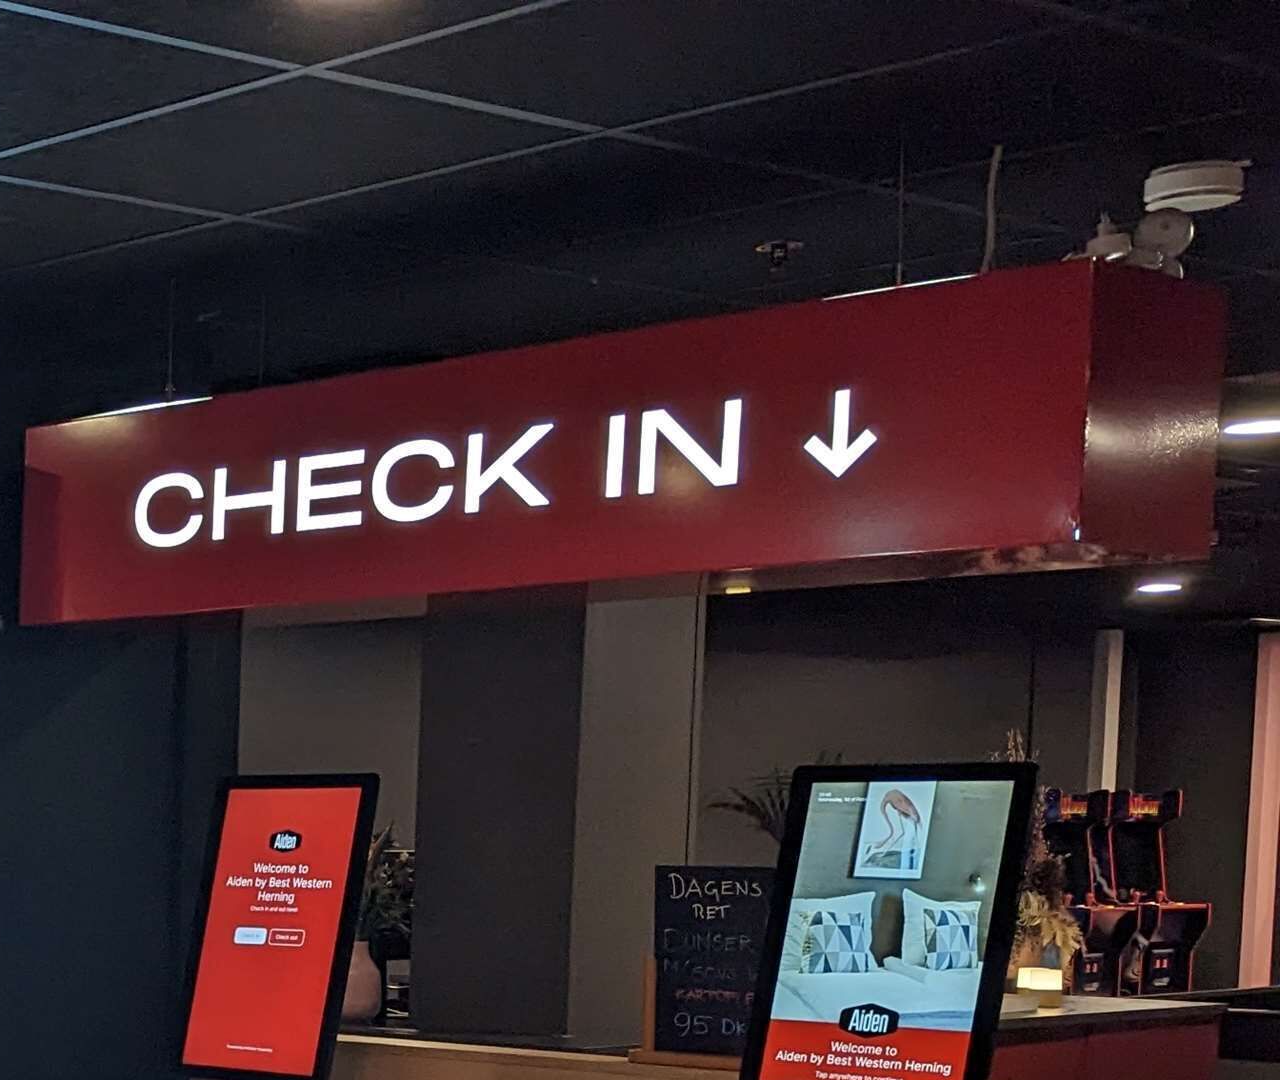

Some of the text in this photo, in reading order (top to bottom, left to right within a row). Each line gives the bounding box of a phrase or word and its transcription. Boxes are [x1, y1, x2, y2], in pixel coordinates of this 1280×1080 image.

[133, 398, 743, 548] CHECK IN
[273, 833, 297, 849] Aiden
[253, 862, 309, 874] Welcome to
[226, 876, 333, 889] Aiden by Best Western
[668, 873, 763, 902] DAGENS
[257, 891, 296, 904] Herning
[691, 903, 731, 920] RET
[674, 1012, 713, 1037] 95
[847, 1009, 889, 1034] Aiden
[830, 1041, 898, 1057] Welcome to
[775, 1050, 952, 1077] Aiden by Best Western Herning
[815, 1070, 828, 1080] Tap
